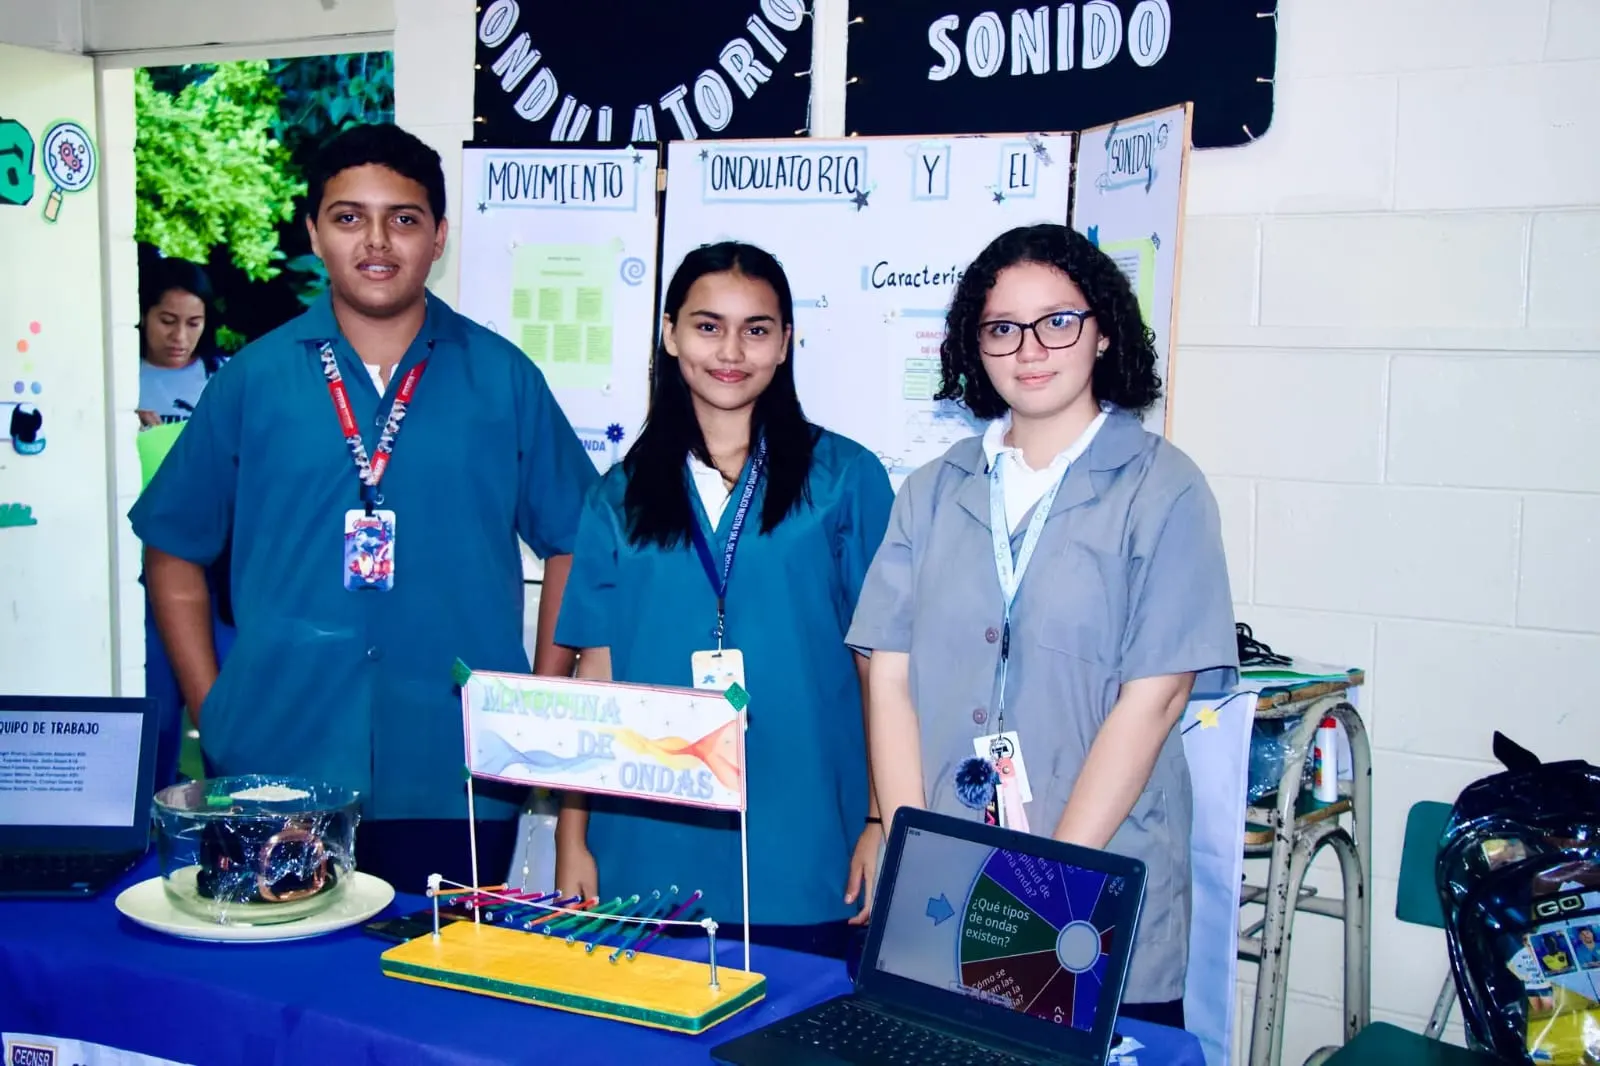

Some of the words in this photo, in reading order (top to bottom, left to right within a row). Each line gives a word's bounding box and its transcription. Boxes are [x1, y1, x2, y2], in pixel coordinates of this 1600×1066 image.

[927, 0, 1171, 81] SONIDO
[488, 161, 624, 204] MOVIMIENTO
[711, 154, 858, 195] ONDULATORIO
[922, 154, 940, 195] Y
[1009, 152, 1030, 189] EL
[1111, 132, 1152, 175] SONIDO
[579, 439, 606, 452] NDA
[482, 682, 622, 724] MAQUINA
[33, 721, 46, 734] DE
[51, 721, 99, 735] TRABAJO
[577, 729, 616, 760] DE
[618, 761, 714, 799] ONDAS
[1014, 867, 1037, 898] onda?
[1017, 852, 1044, 884] plitud
[1040, 884, 1050, 899] de
[969, 911, 983, 925] de
[985, 917, 1018, 934] ondas
[971, 897, 1001, 912] ¿Qué
[1002, 904, 1030, 921] tipos
[966, 928, 1010, 948] existen?
[995, 968, 1006, 979] se
[14, 1048, 50, 1066] CECNSR
